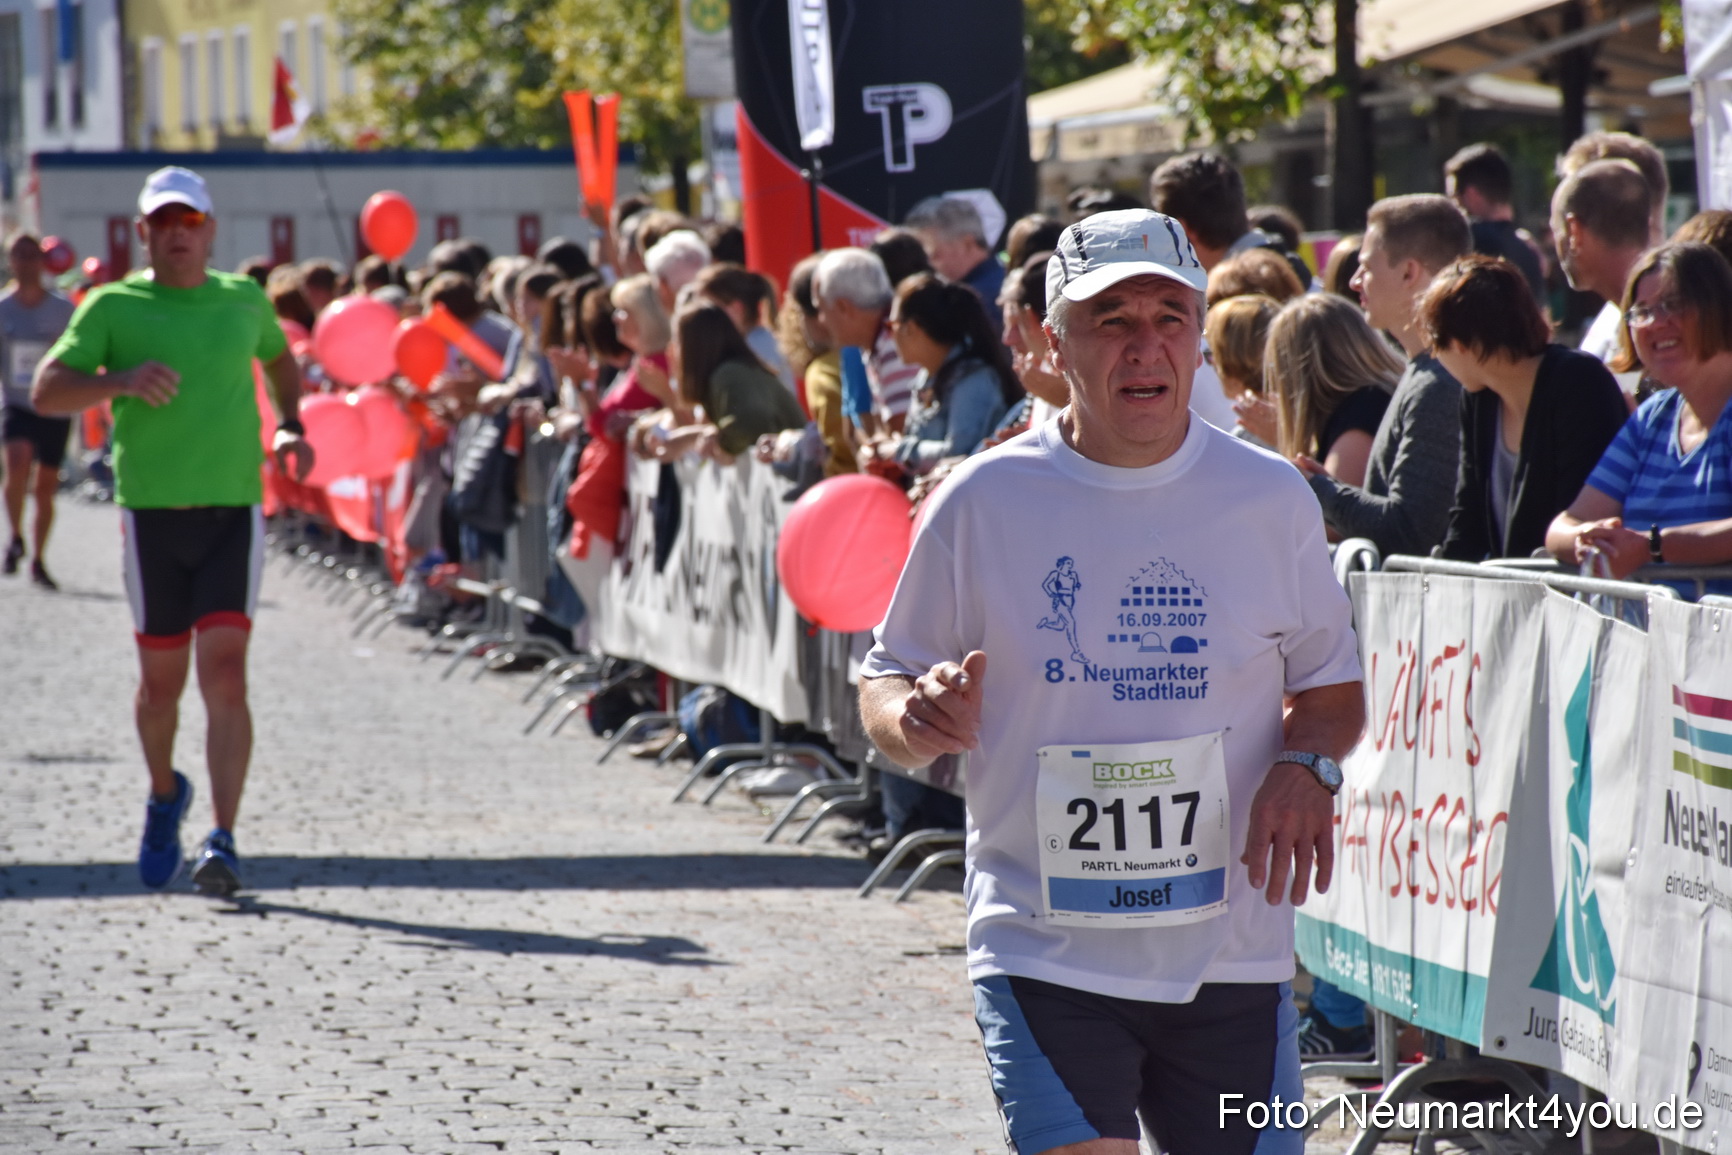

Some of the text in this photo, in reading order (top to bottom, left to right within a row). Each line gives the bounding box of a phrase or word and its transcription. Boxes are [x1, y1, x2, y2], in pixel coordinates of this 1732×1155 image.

[1117, 613, 1207, 627] 16.09.2007
[1045, 658, 1209, 683] 8. Neumarkter
[1112, 681, 1209, 701] Stadtlauf
[1093, 759, 1175, 781] BOCK
[1067, 791, 1200, 851] 2117
[1051, 839, 1057, 849] C
[1081, 858, 1181, 872] PARTL Neumarkt
[1109, 882, 1172, 908] Josef
[1523, 1007, 1557, 1043] Jura
